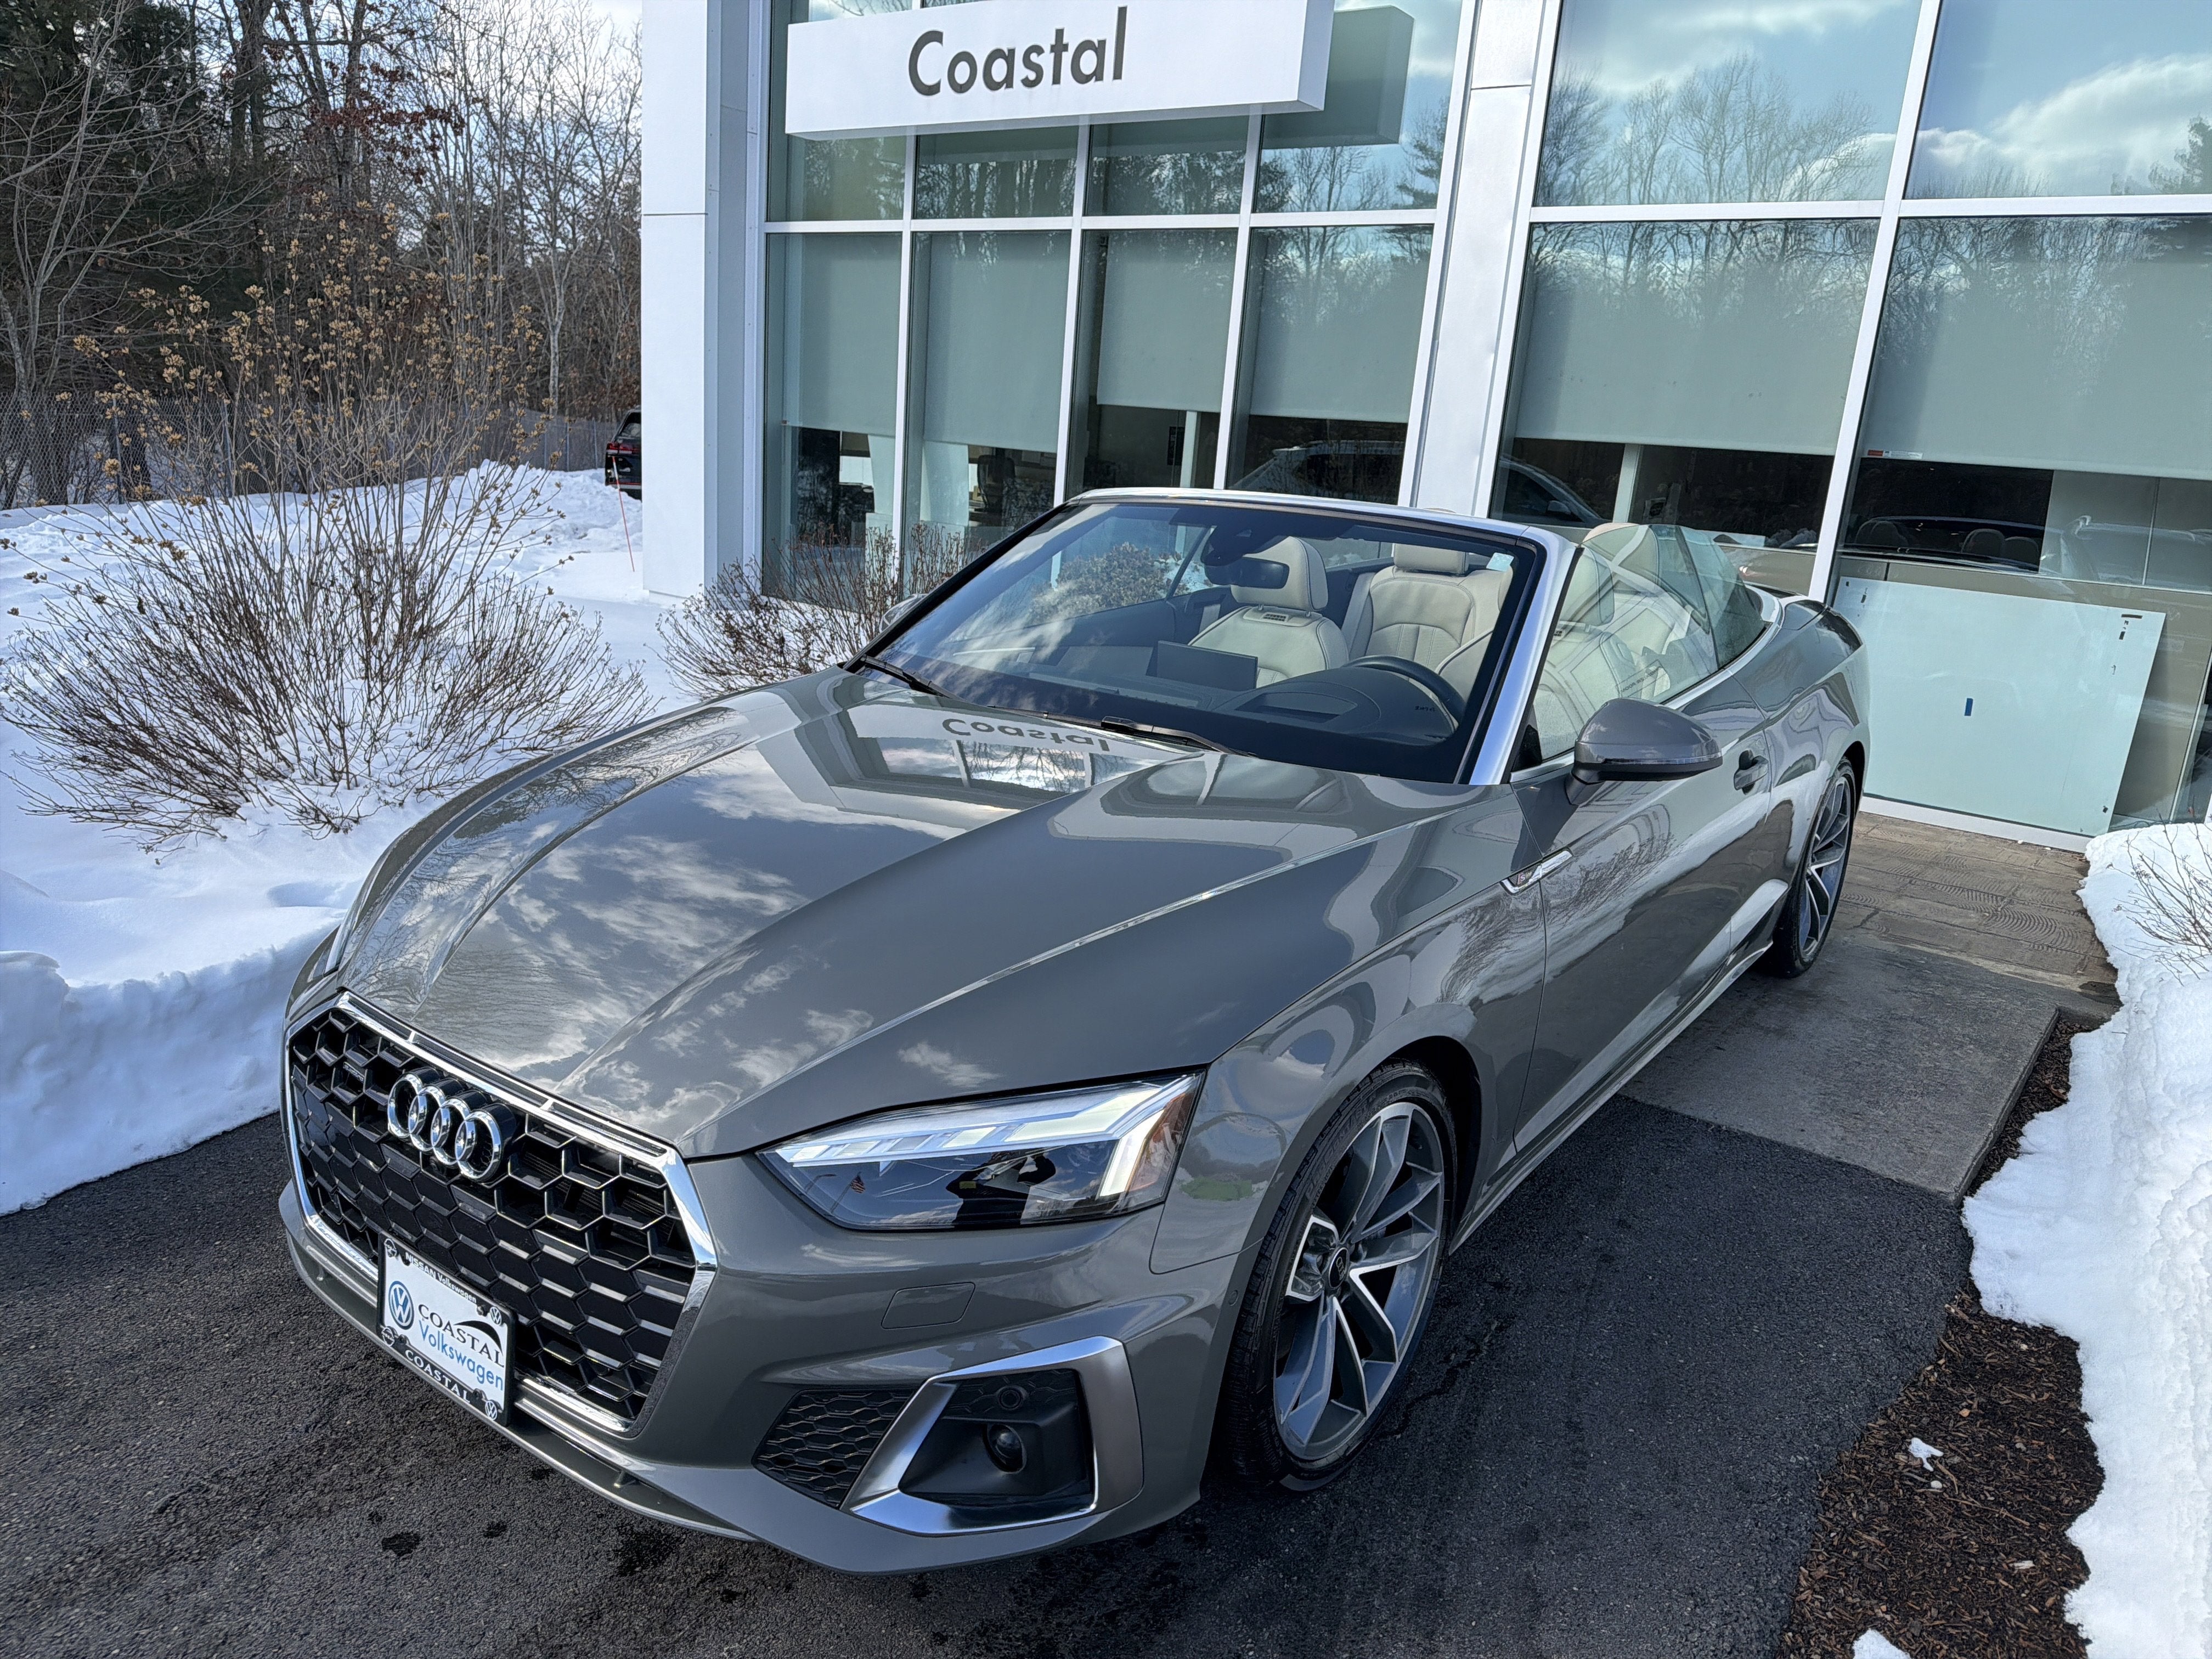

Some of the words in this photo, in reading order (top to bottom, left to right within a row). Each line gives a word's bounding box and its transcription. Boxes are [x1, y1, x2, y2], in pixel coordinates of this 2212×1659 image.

[909, 5, 1128, 96] Coastal
[405, 1252, 437, 1279] NISSAN
[438, 1272, 477, 1304] Volkswagen
[418, 1304, 505, 1368] COASTAL
[419, 1319, 503, 1391] Volkswagen
[405, 1350, 470, 1403] COASTAL
